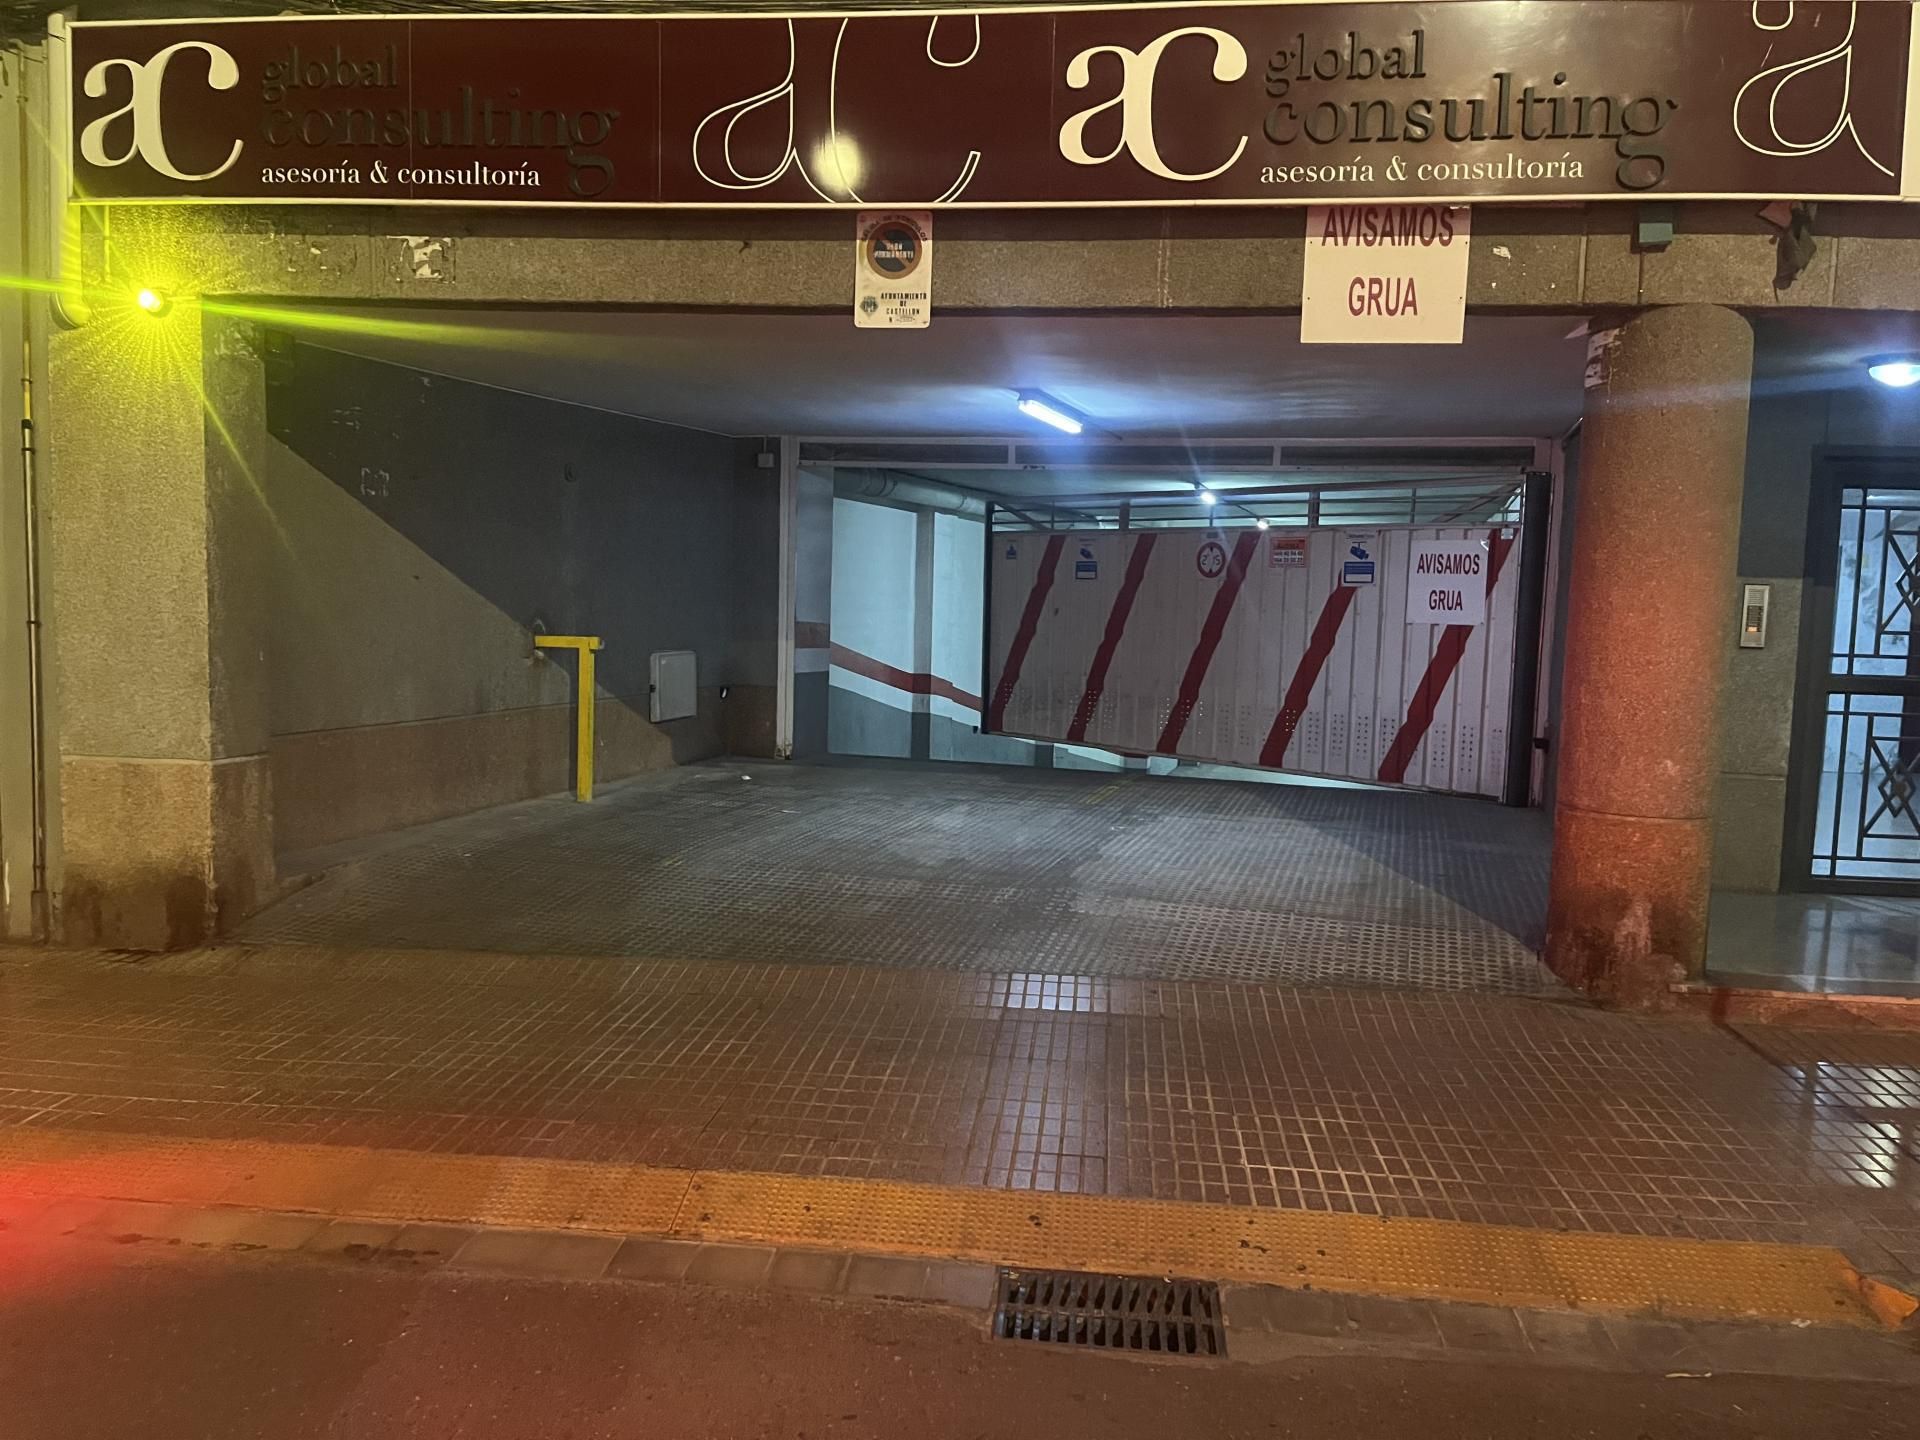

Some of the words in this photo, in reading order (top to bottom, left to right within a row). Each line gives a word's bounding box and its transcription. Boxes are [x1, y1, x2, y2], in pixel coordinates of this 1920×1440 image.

[262, 43, 398, 103] global
[1264, 29, 1427, 98] global
[259, 85, 621, 197] consulting
[1262, 71, 1679, 191] consulting
[261, 159, 361, 184] asesoría
[370, 159, 389, 184] &
[397, 160, 542, 186] consultoría
[1260, 155, 1375, 183] asesoría
[1385, 155, 1409, 182] &
[1417, 151, 1585, 182] consultoría
[1321, 206, 1454, 247] AVISAMOS
[1348, 276, 1418, 317] GRUA
[1416, 553, 1480, 575] AVISAMOS
[1429, 589, 1463, 611] GRUA
